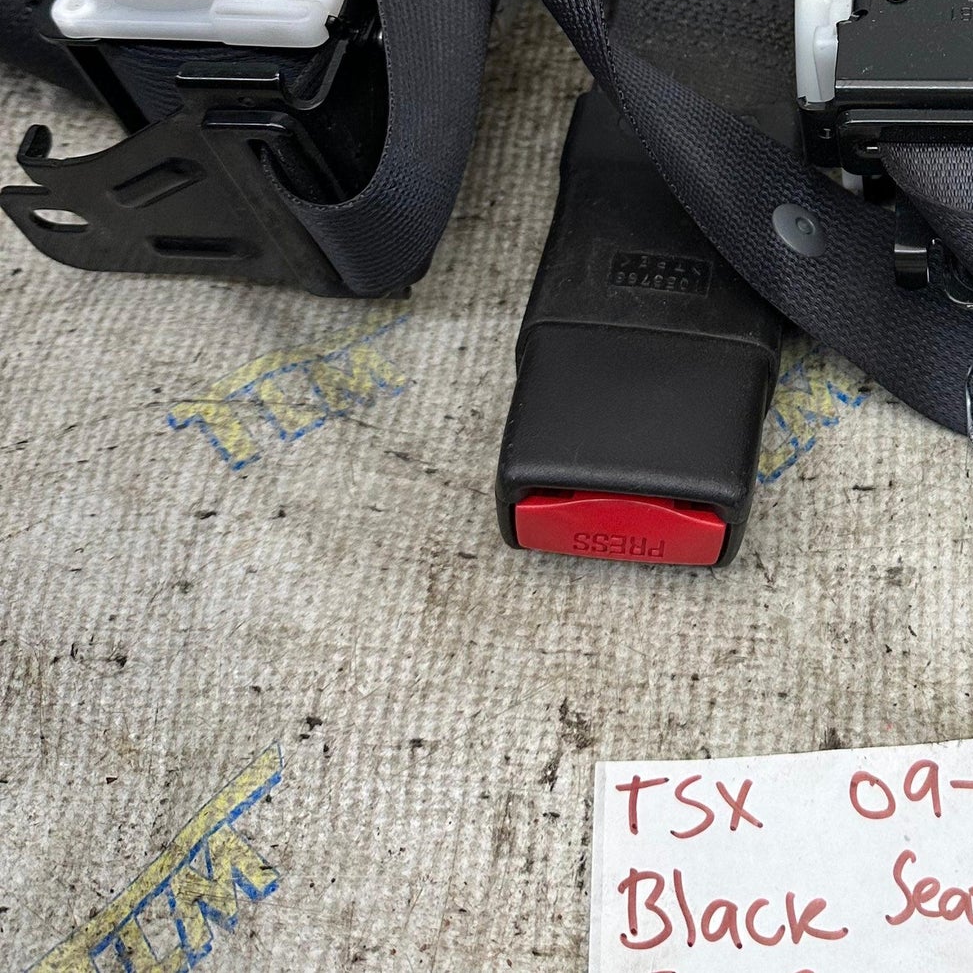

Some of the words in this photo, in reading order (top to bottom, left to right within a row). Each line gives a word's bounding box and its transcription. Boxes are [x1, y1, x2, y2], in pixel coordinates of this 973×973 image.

[572, 532, 665, 558] PRESS
[615, 774, 764, 839] TSX
[617, 867, 849, 950] Black
